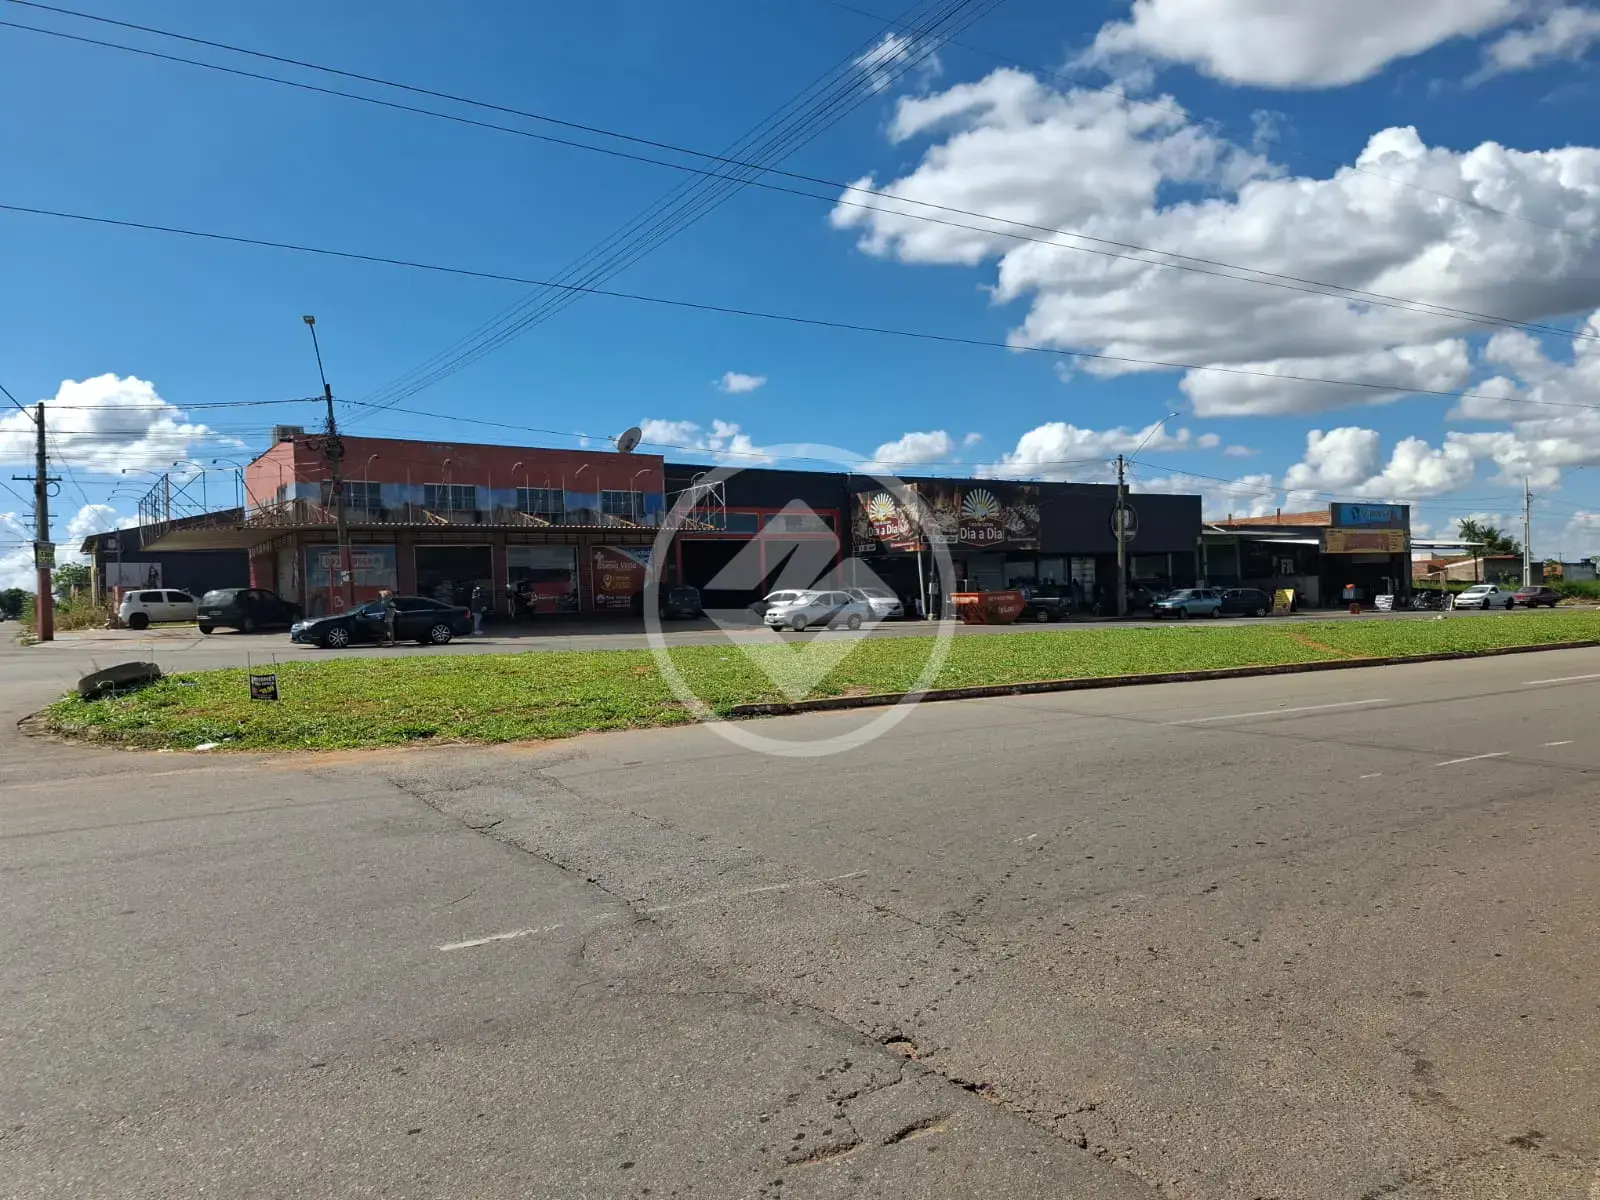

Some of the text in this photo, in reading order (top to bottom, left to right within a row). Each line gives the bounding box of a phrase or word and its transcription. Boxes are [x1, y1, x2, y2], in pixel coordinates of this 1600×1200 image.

[886, 523, 898, 535] Dia
[960, 527, 977, 540] Dia
[978, 530, 985, 540] a
[986, 527, 1003, 540] Dia
